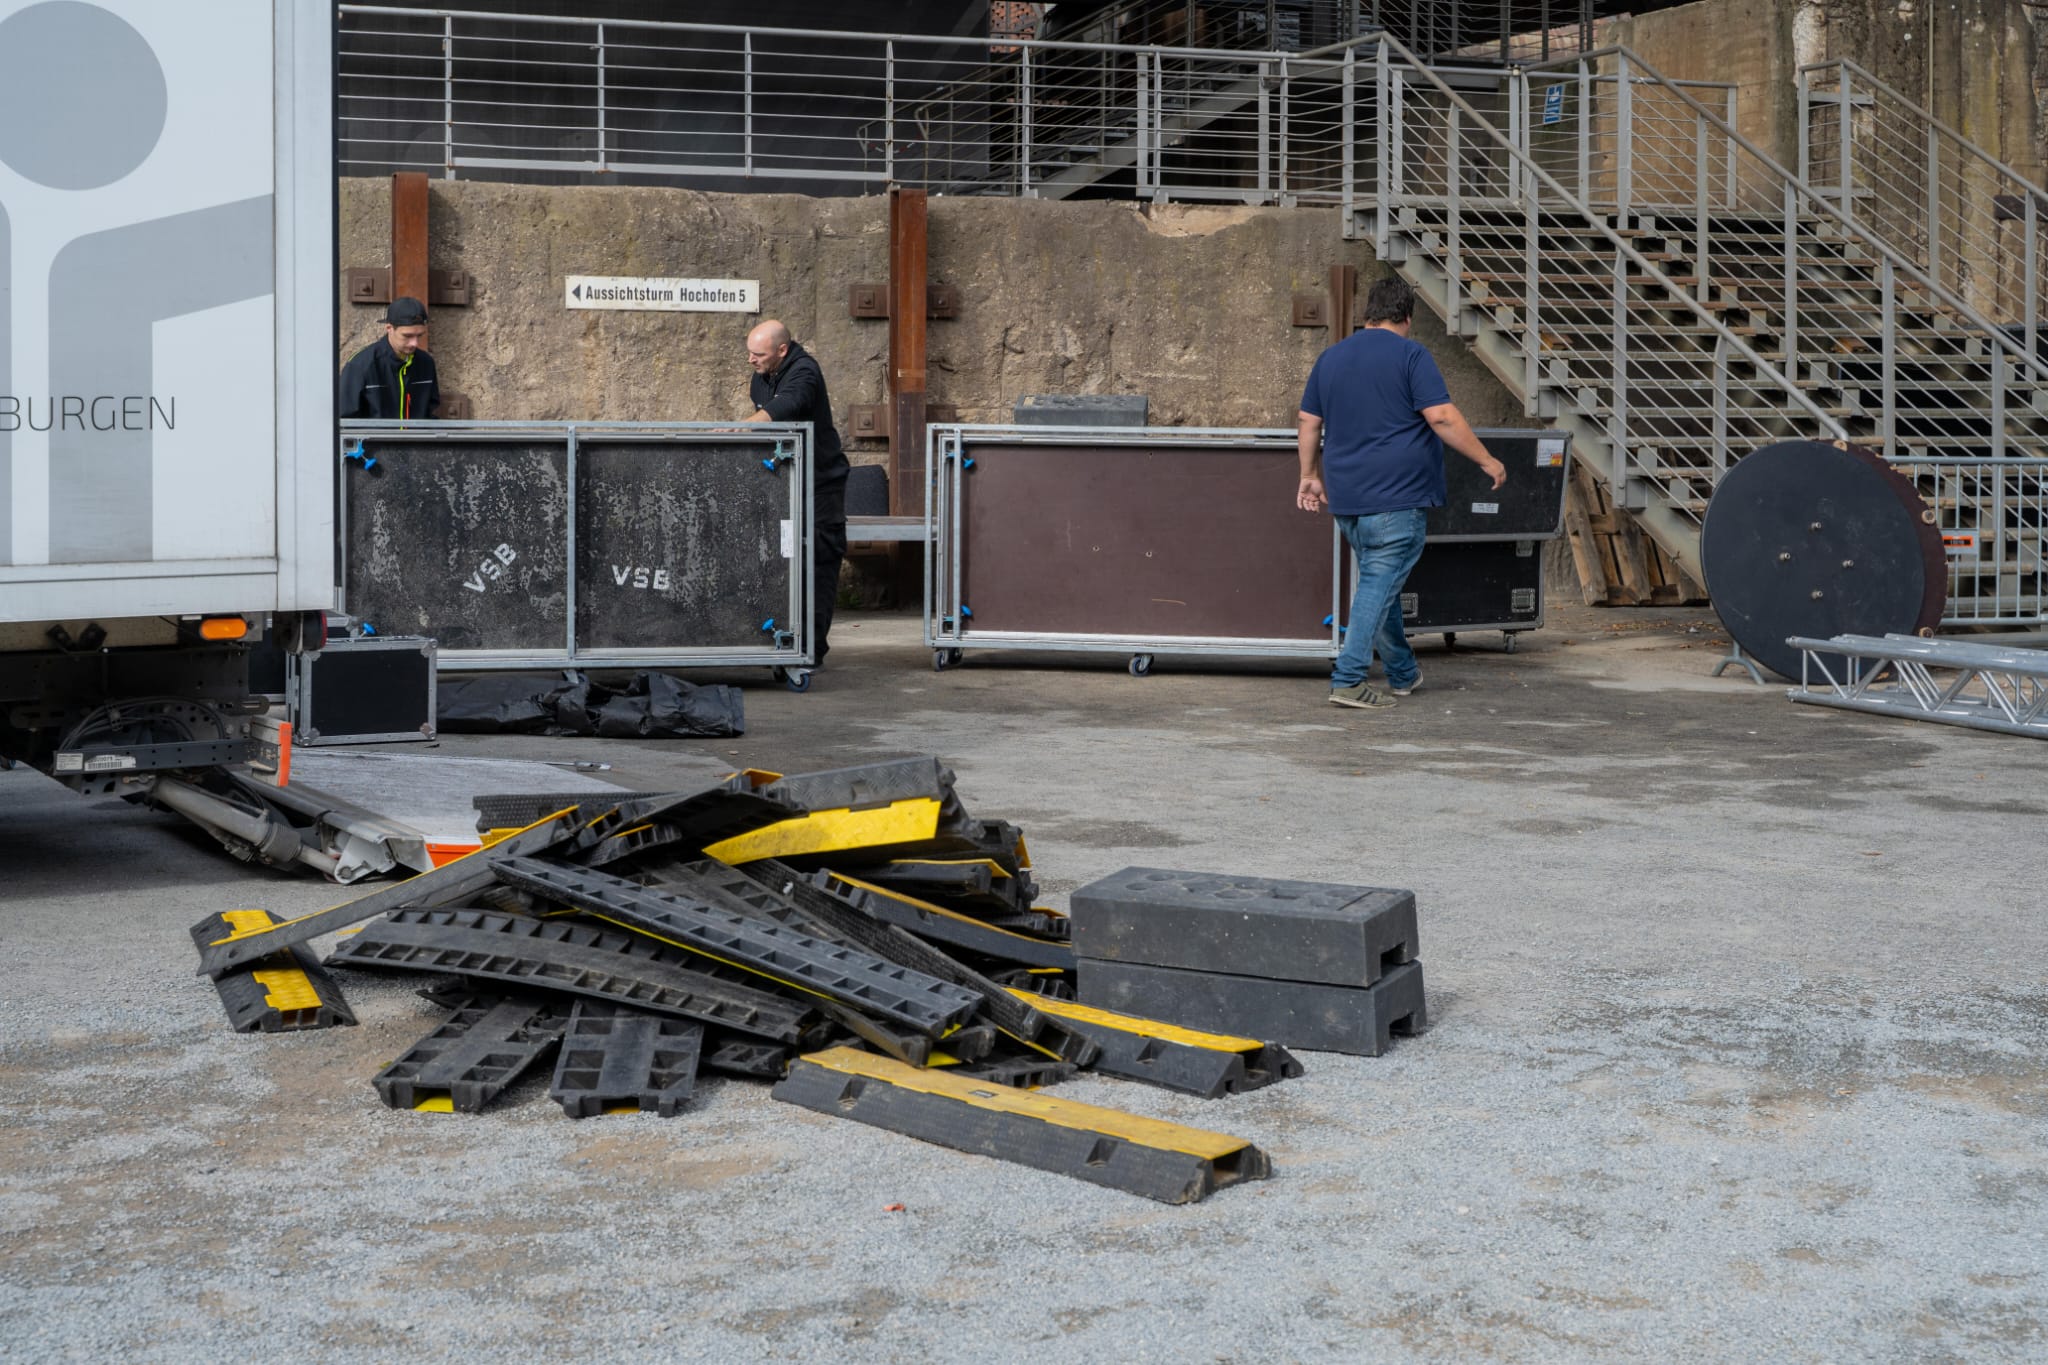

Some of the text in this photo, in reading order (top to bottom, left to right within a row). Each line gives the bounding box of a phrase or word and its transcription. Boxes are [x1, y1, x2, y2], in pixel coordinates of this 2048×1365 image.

[586, 286, 746, 303] Aussichtsturm Hochofen 5
[0, 396, 175, 431] BURGEN
[463, 543, 517, 593] VSB
[612, 565, 670, 590] VSB
